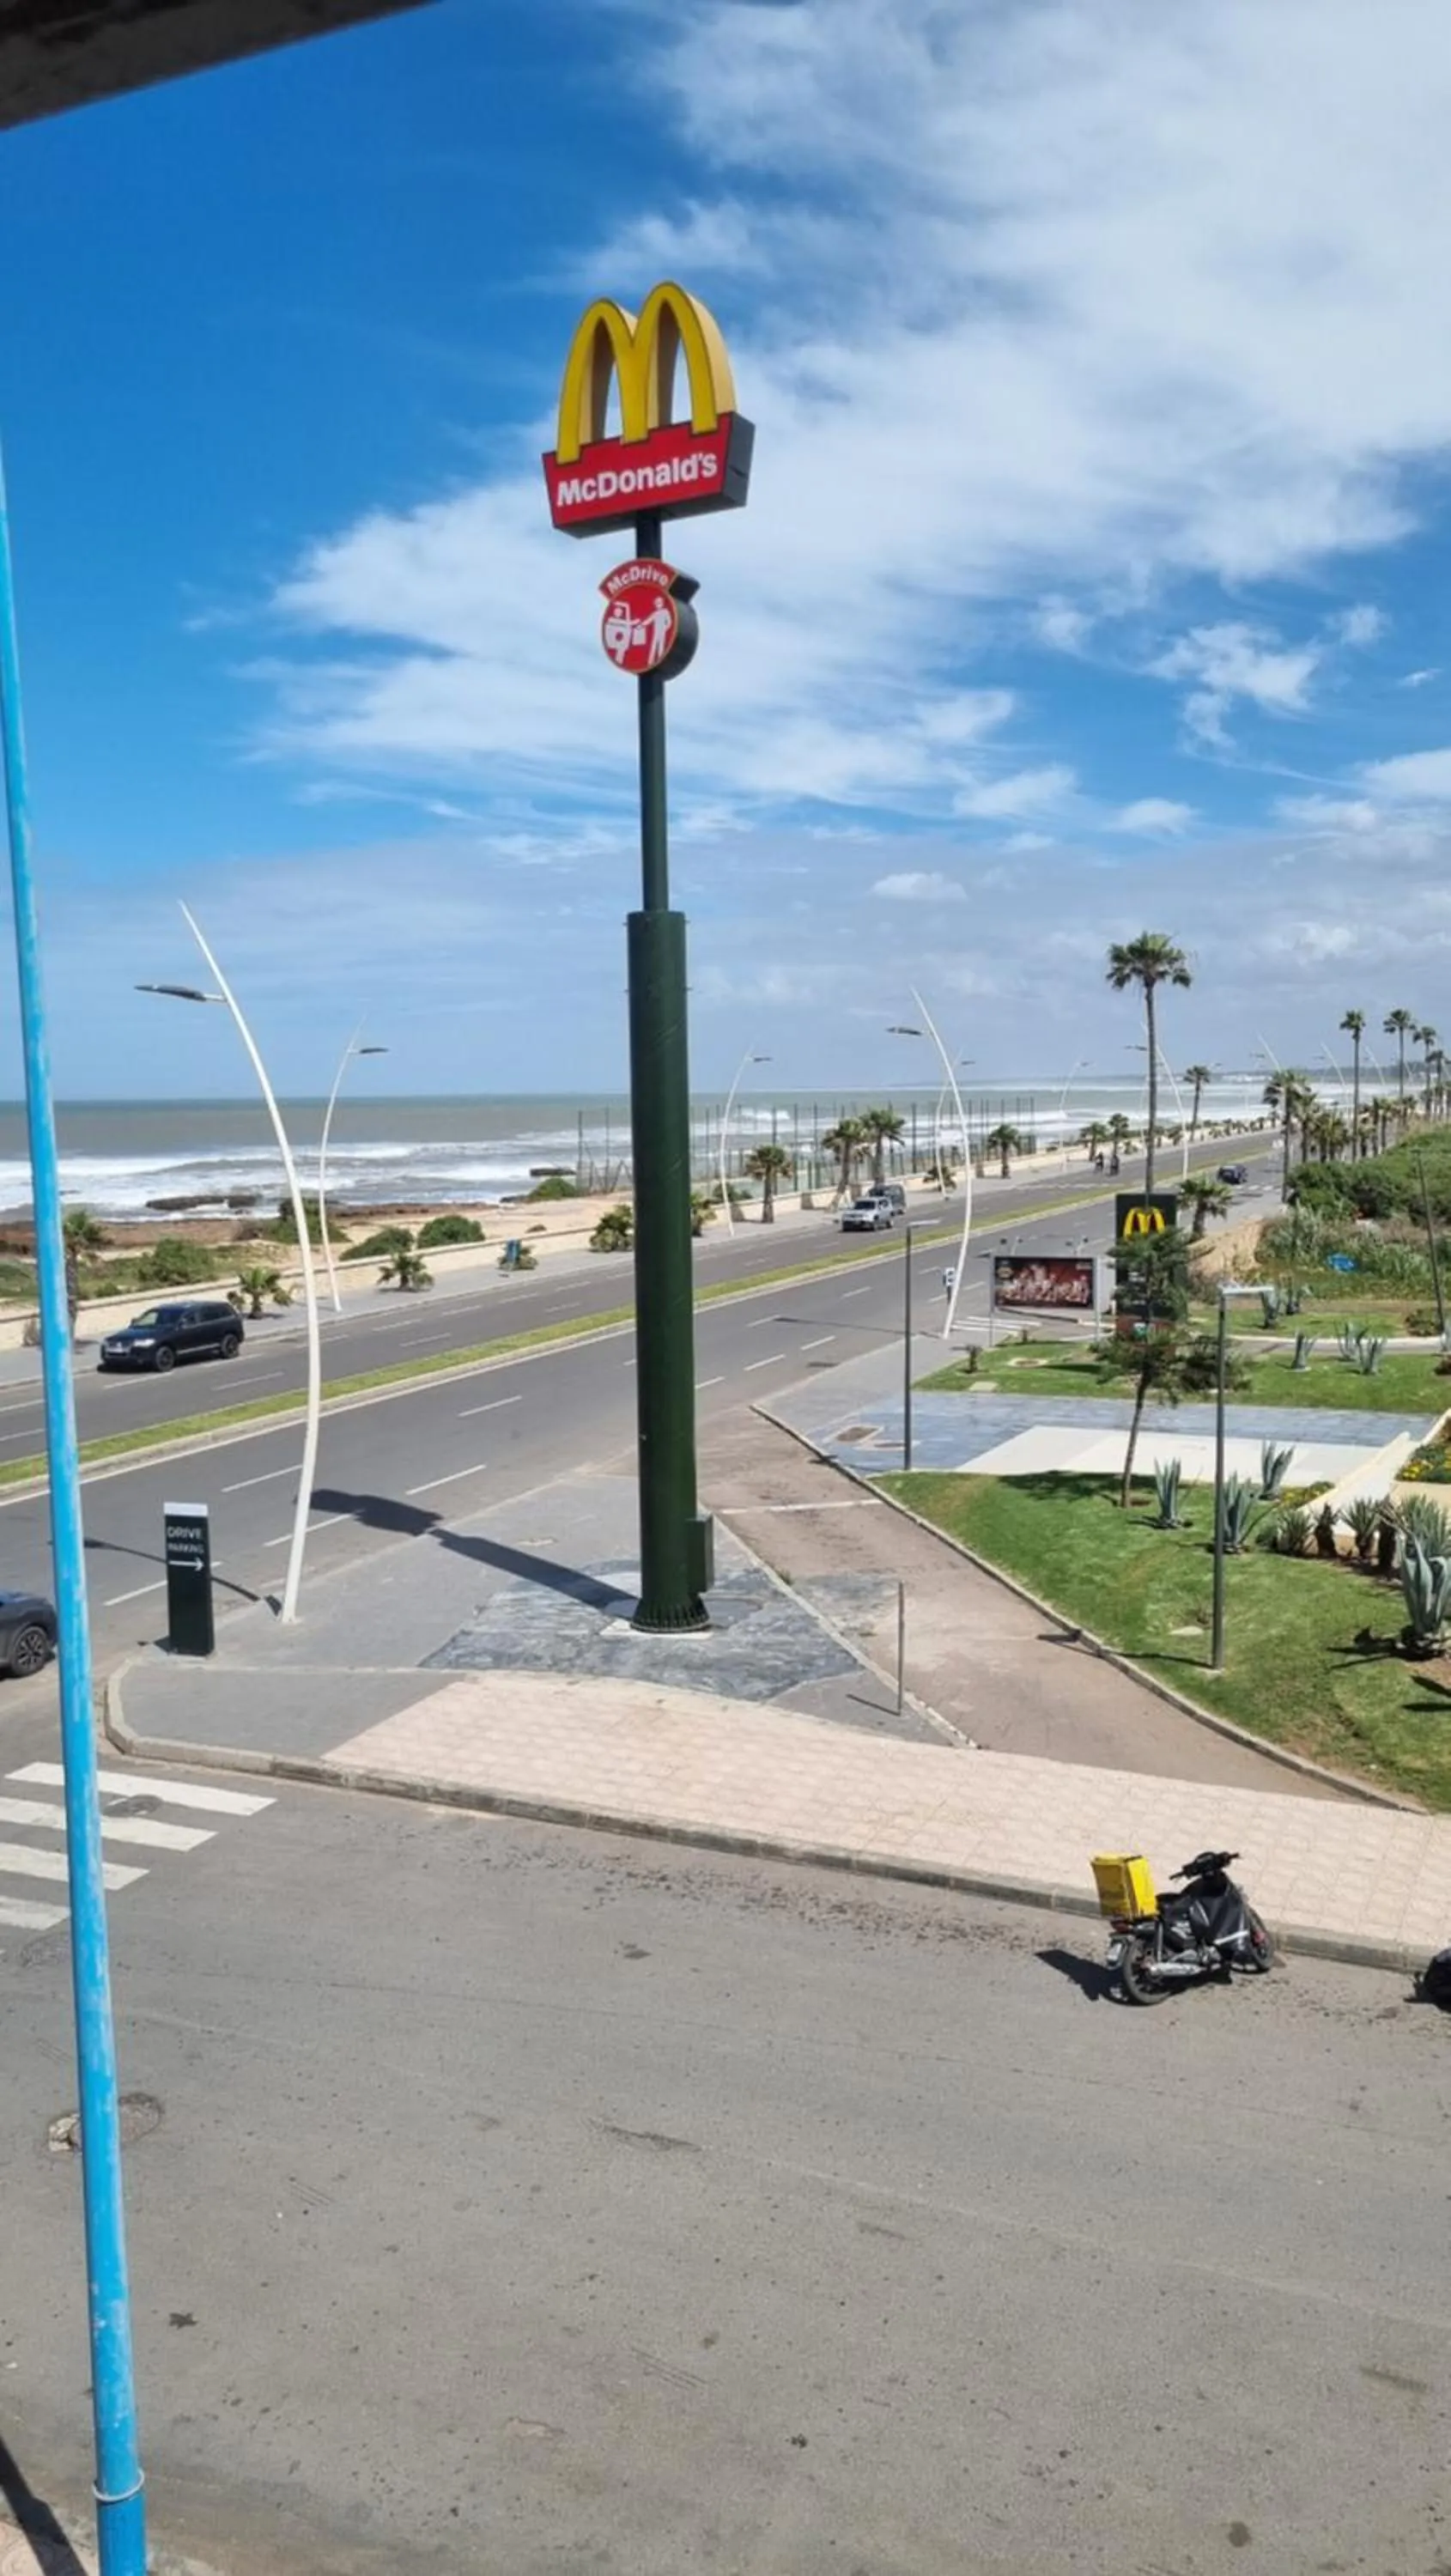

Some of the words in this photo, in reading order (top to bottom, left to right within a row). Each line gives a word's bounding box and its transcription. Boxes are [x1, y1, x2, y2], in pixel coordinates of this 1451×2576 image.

[557, 453, 718, 507] McDonald's
[607, 565, 669, 594] McDrive
[167, 1526, 202, 1540] DRIVE
